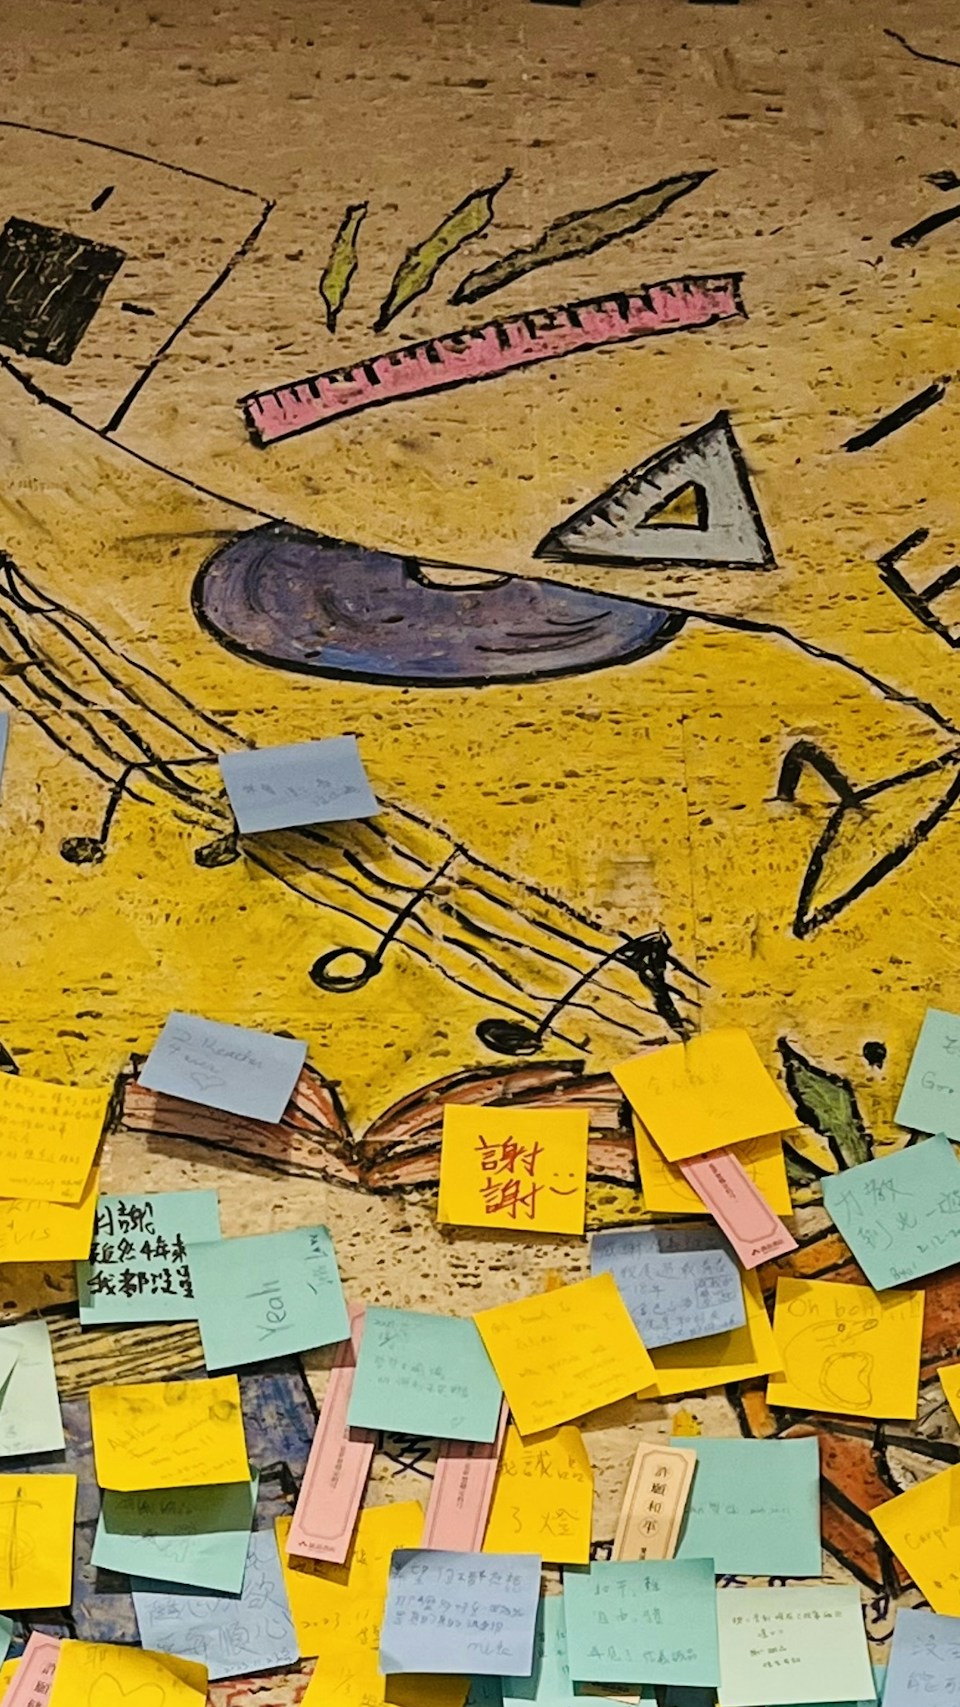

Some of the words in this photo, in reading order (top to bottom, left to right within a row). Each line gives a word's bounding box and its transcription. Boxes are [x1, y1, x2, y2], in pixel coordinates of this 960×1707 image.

[477, 1136, 545, 1175] 謝
[480, 1177, 545, 1219] 謝
[638, 1463, 676, 1536] 許願和平
